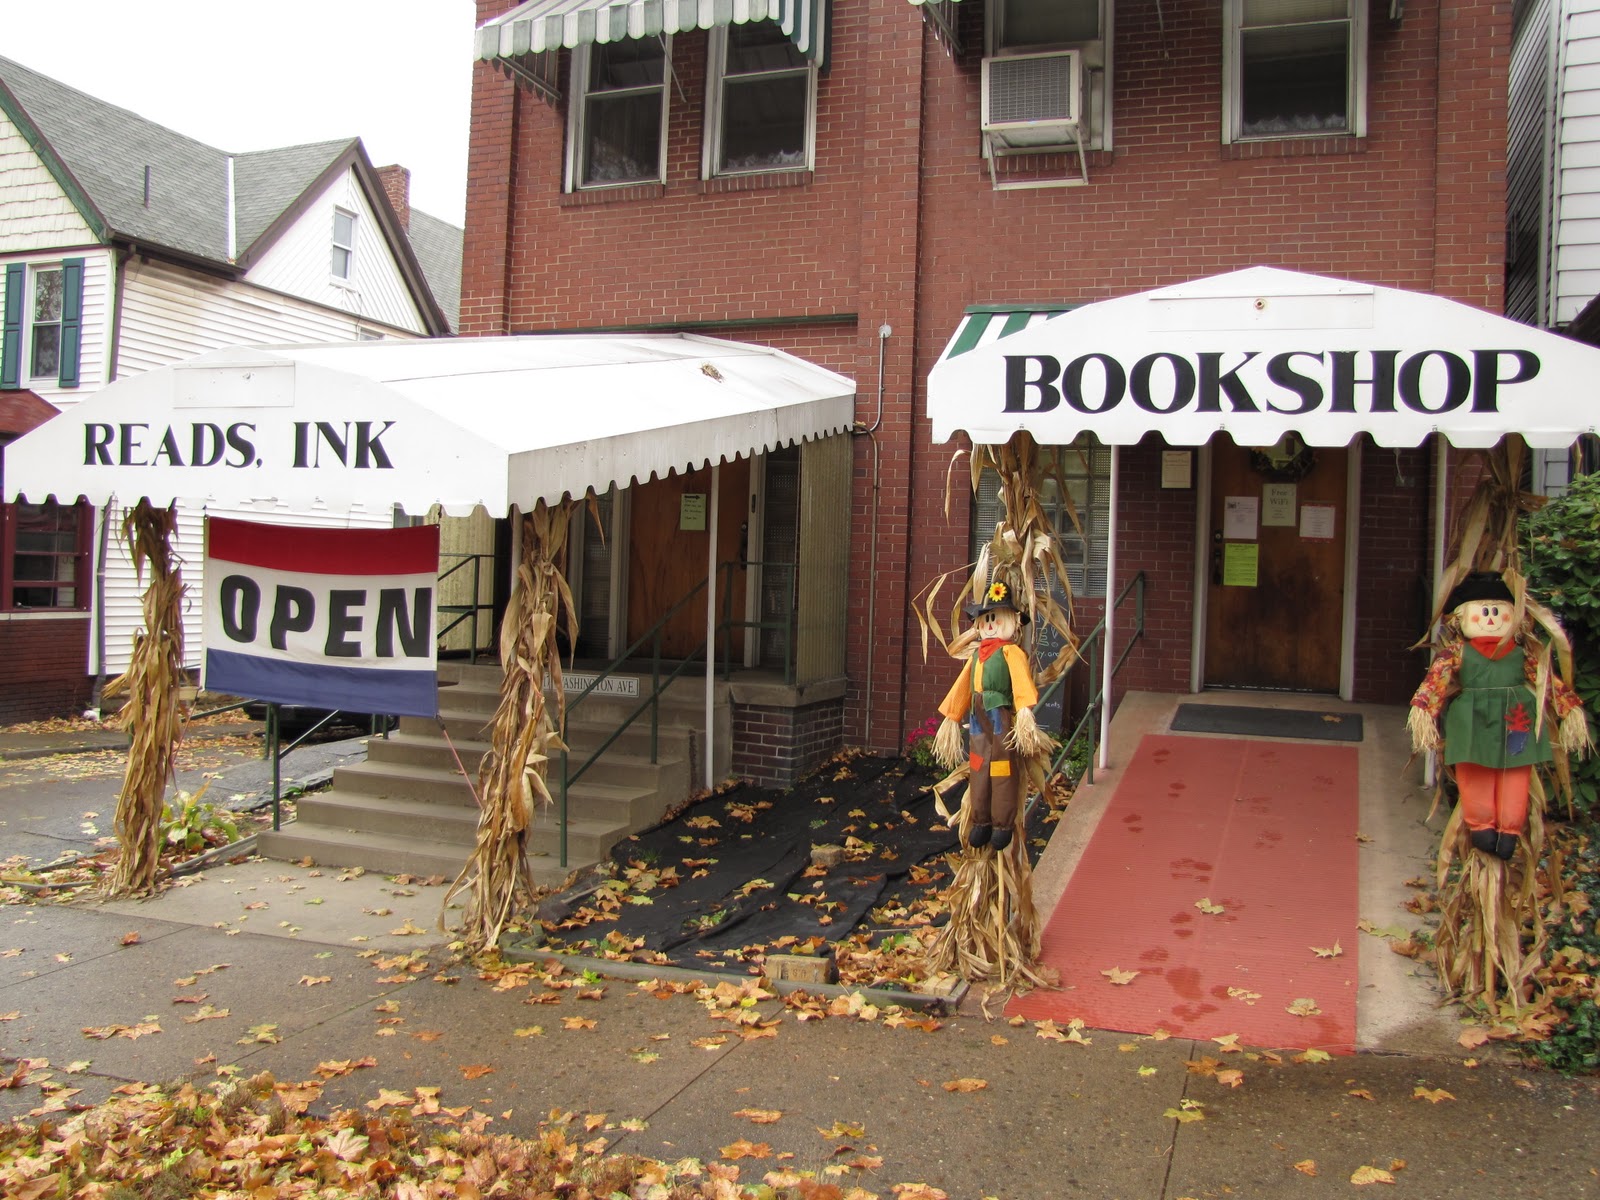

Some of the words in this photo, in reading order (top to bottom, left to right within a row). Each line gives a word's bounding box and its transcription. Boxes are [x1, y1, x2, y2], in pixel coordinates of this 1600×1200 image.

[1001, 349, 1541, 414] BOOKSHOP
[83, 422, 263, 468] READS,
[292, 421, 397, 469] INK
[220, 574, 433, 658] OPEN
[561, 677, 613, 692] ASHINON
[617, 681, 636, 693] AVE.
